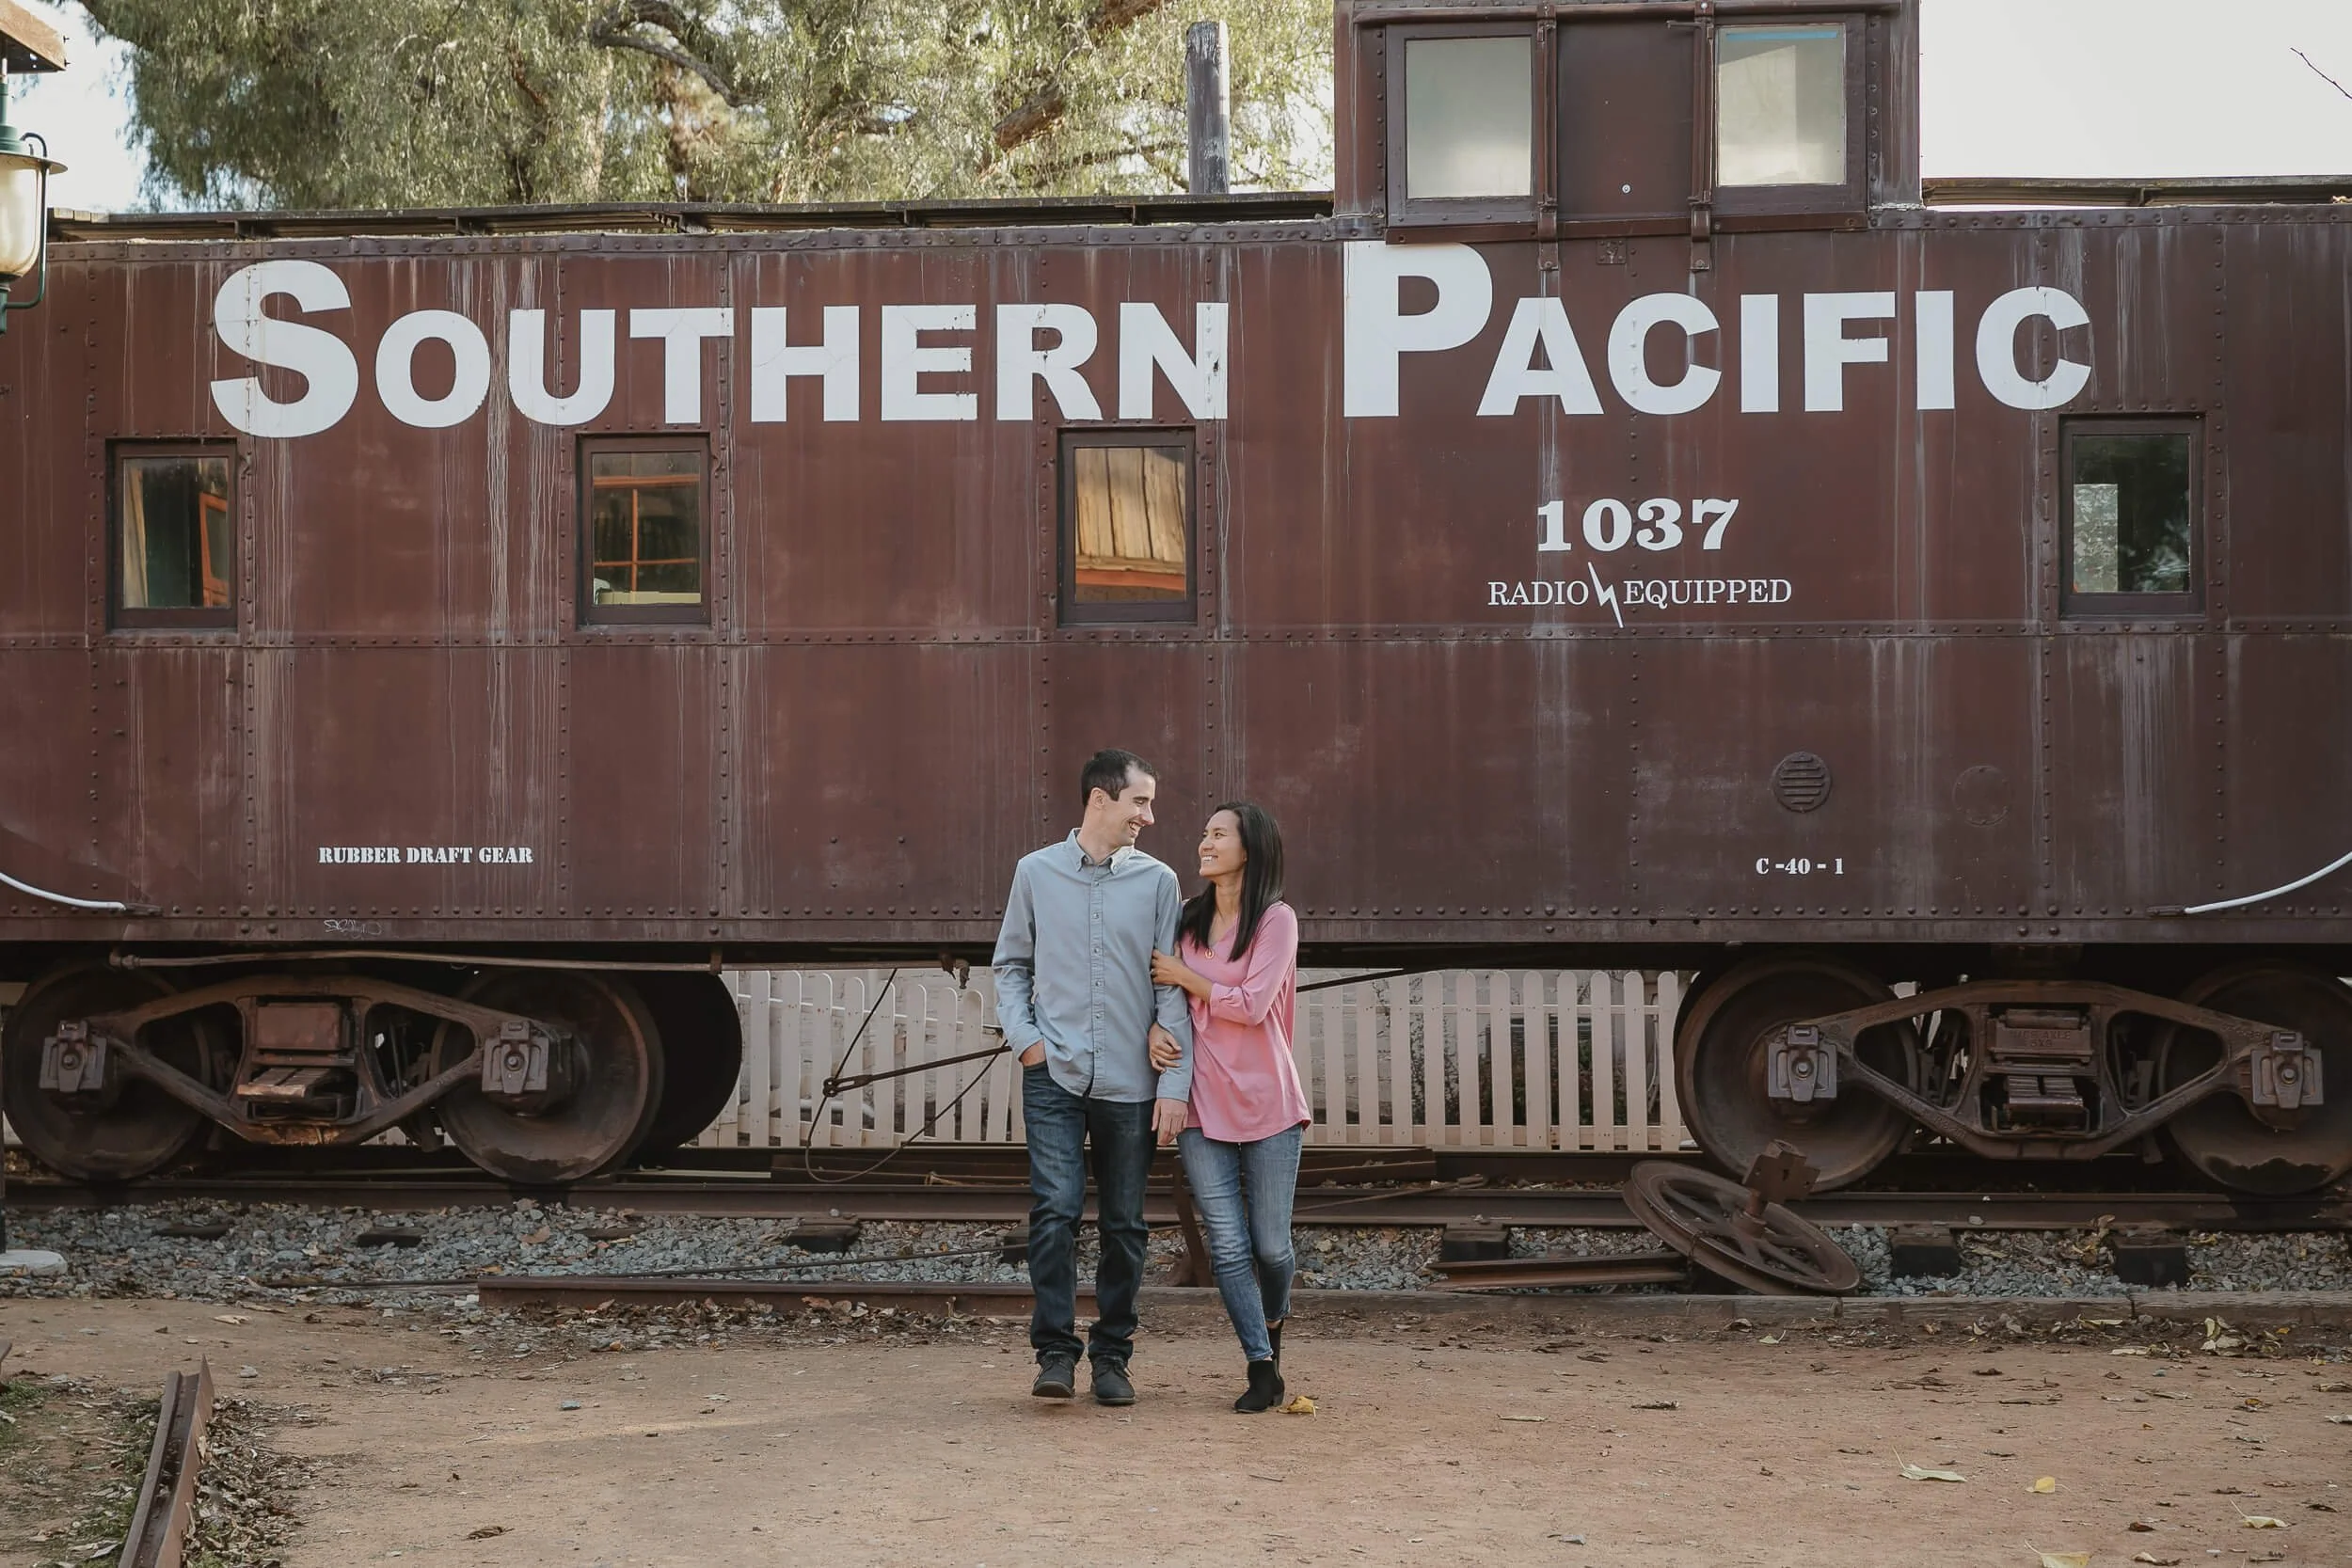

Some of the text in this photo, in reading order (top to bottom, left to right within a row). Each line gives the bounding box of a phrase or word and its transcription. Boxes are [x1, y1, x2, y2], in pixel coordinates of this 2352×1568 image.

[211, 241, 2092, 438] SOUTHERN PACIFIC
[1536, 498, 1740, 552] 1037
[1486, 578, 1793, 610] RADIO EQUIPPED
[318, 847, 534, 864] RUBBER DRAFT GEAR
